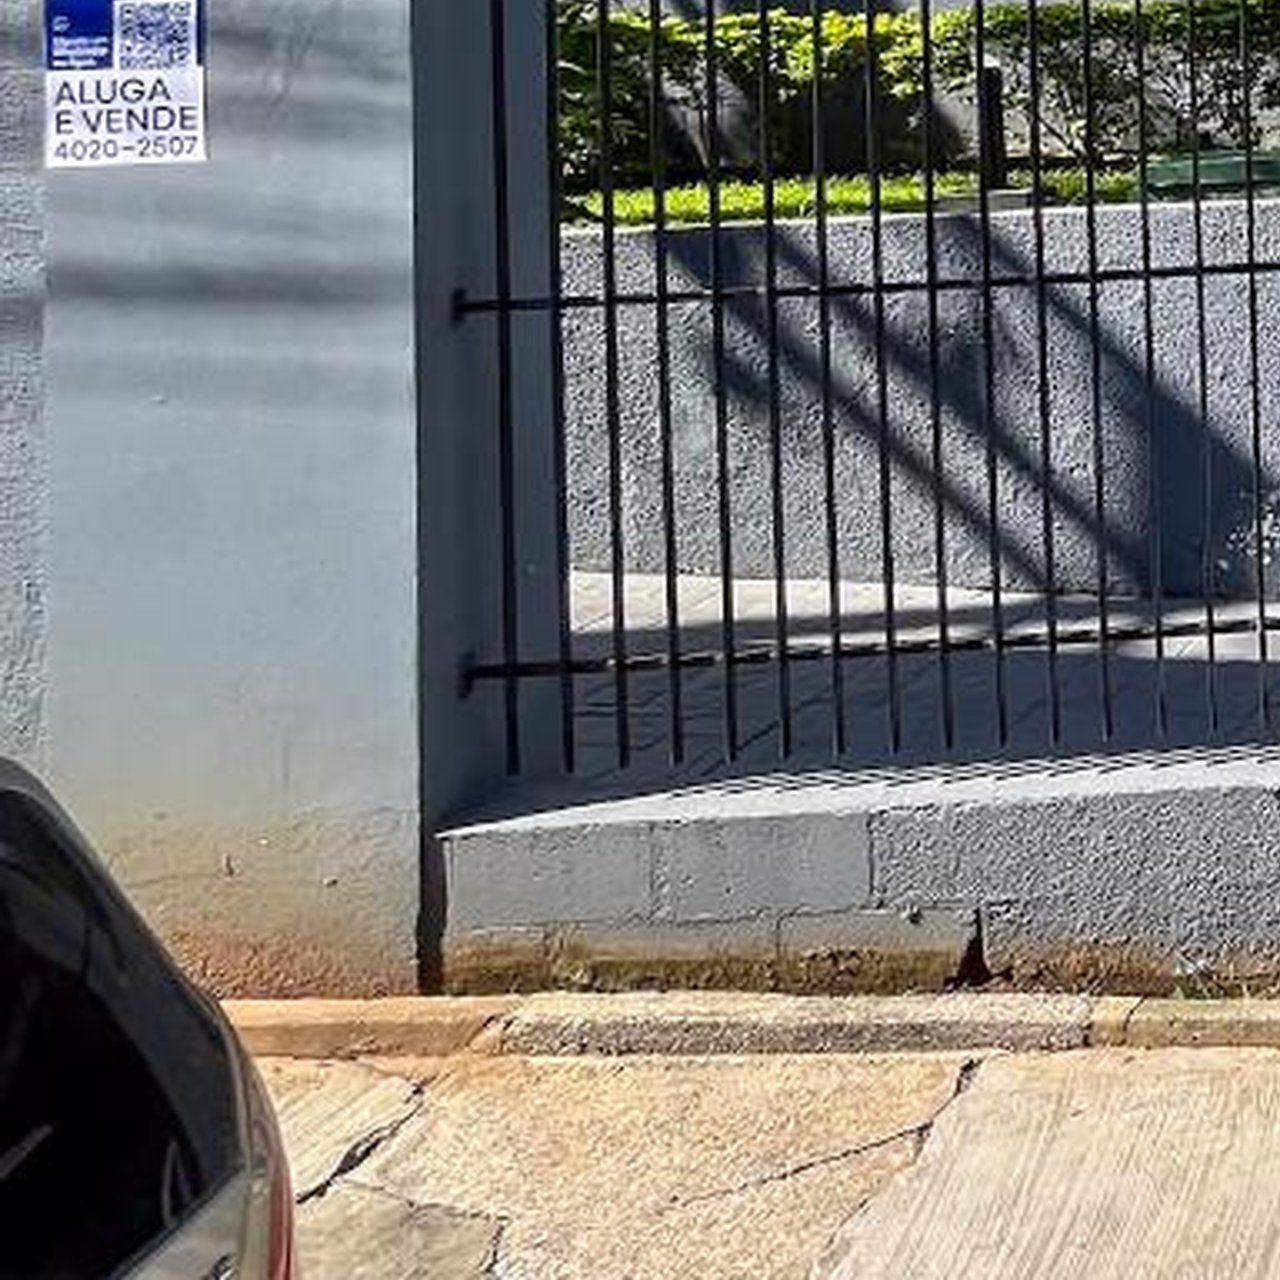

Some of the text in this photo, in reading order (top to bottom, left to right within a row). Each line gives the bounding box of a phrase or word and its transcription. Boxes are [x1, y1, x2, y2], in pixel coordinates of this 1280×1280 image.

[55, 78, 171, 106] ALUGA
[55, 106, 198, 135] E VENDE
[54, 135, 198, 161] 4020-2507
